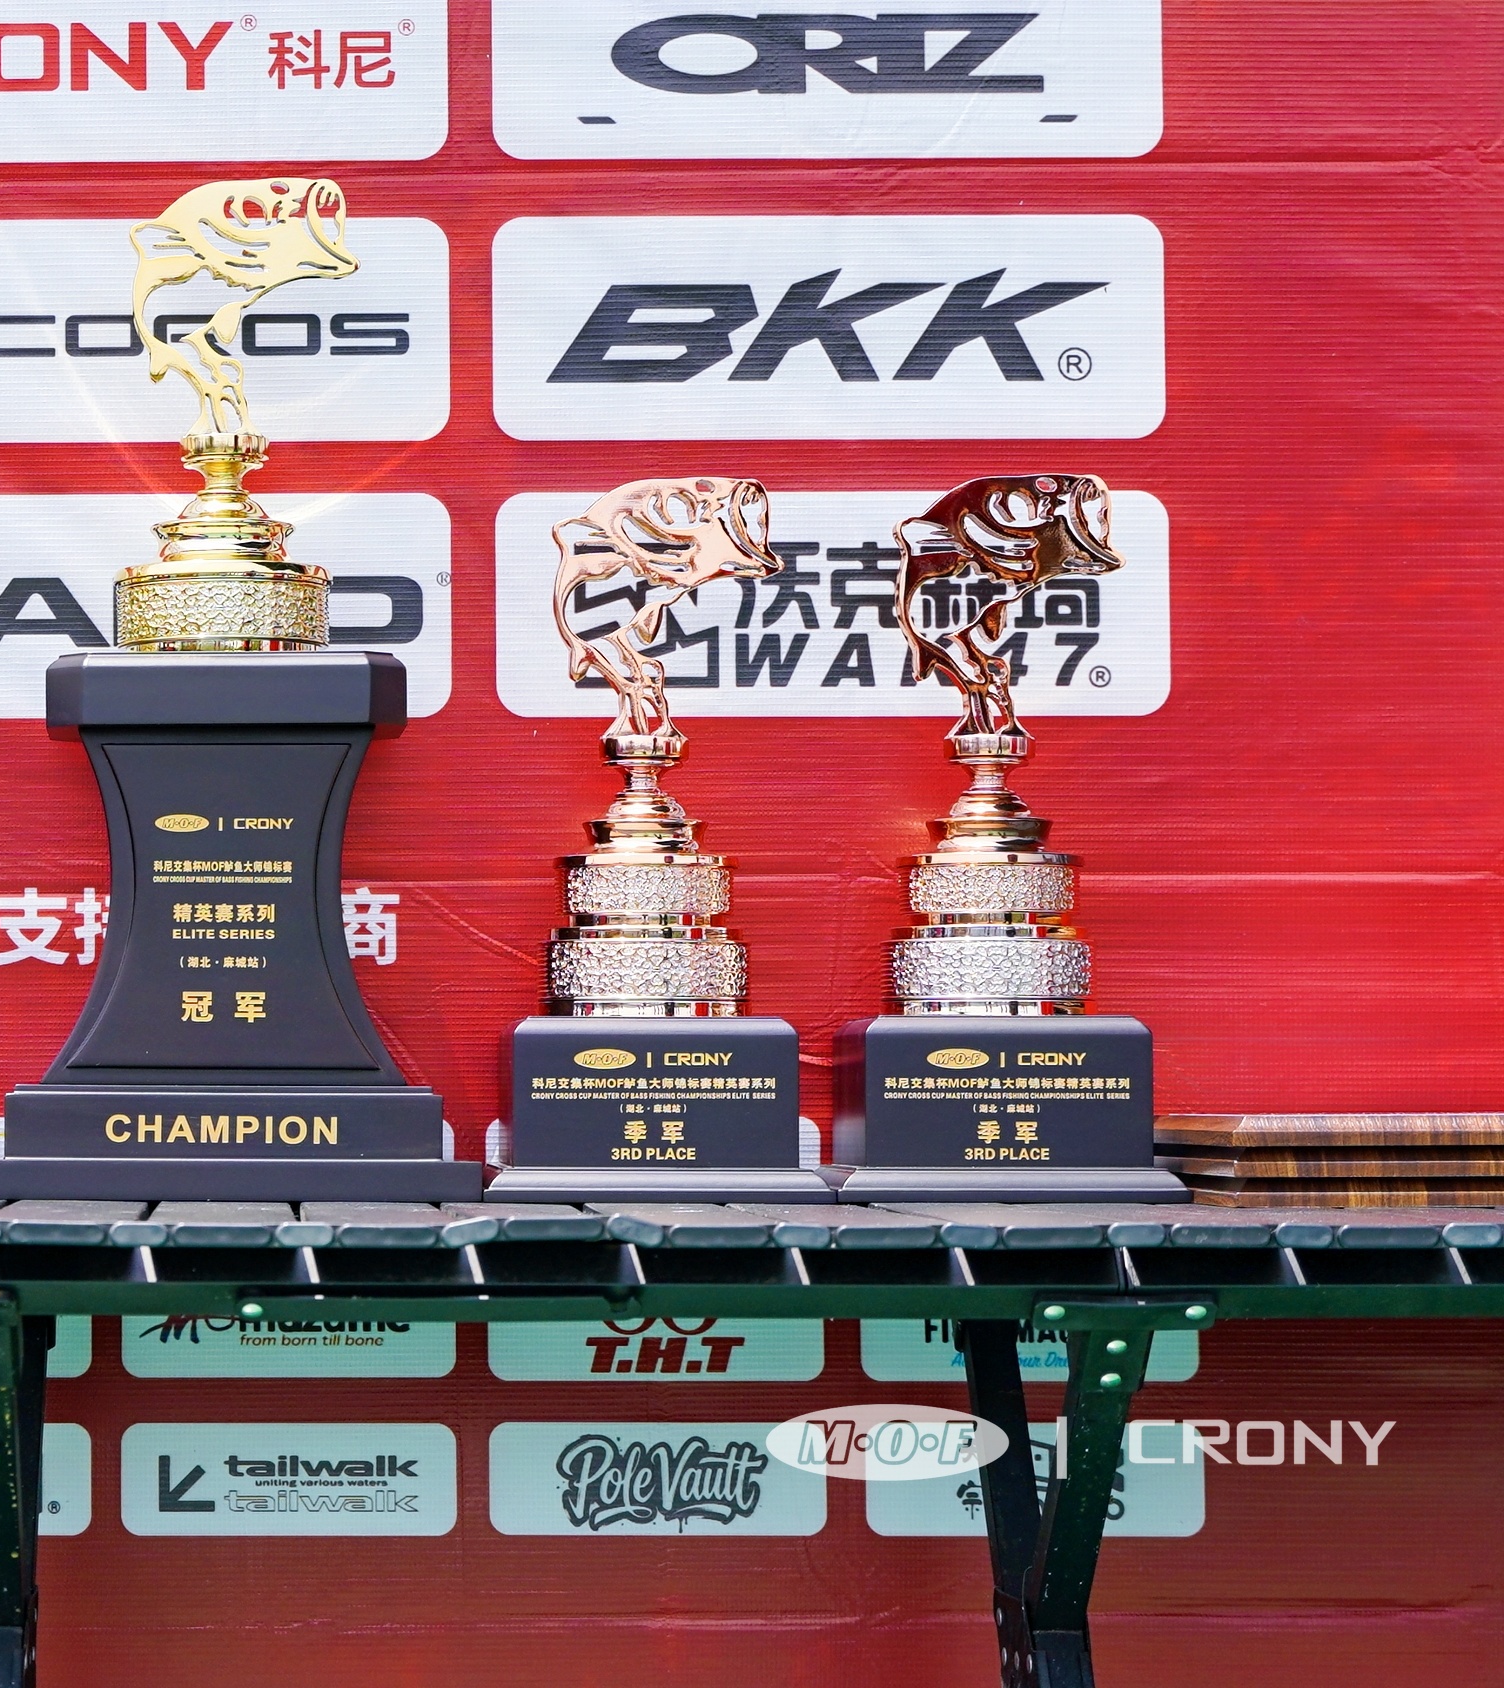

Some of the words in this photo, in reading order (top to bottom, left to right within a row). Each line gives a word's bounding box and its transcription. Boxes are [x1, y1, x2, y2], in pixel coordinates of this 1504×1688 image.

[268, 29, 396, 90] 科尼
[546, 267, 1112, 383] BKK
[233, 818, 294, 830] CRONY
[173, 903, 276, 923] 精英赛系列
[172, 929, 215, 939] ELITE
[219, 929, 275, 939] SERIES
[664, 1052, 733, 1066] CRONY
[1017, 1052, 1086, 1066] CRONY
[105, 1114, 338, 1145] CHAMPION
[611, 1147, 642, 1160] 3RD
[646, 1147, 696, 1160] PLACE
[964, 1148, 995, 1161] 3RD
[999, 1148, 1050, 1161] PLACE
[240, 1334, 276, 1346] from
[281, 1334, 317, 1346] born
[322, 1334, 340, 1346] till
[345, 1334, 384, 1346] bone
[224, 1455, 419, 1477] tailwalk
[255, 1479, 296, 1488] uniting
[299, 1479, 344, 1487] various
[347, 1479, 388, 1487] waters
[224, 1490, 419, 1512] tailwalk
